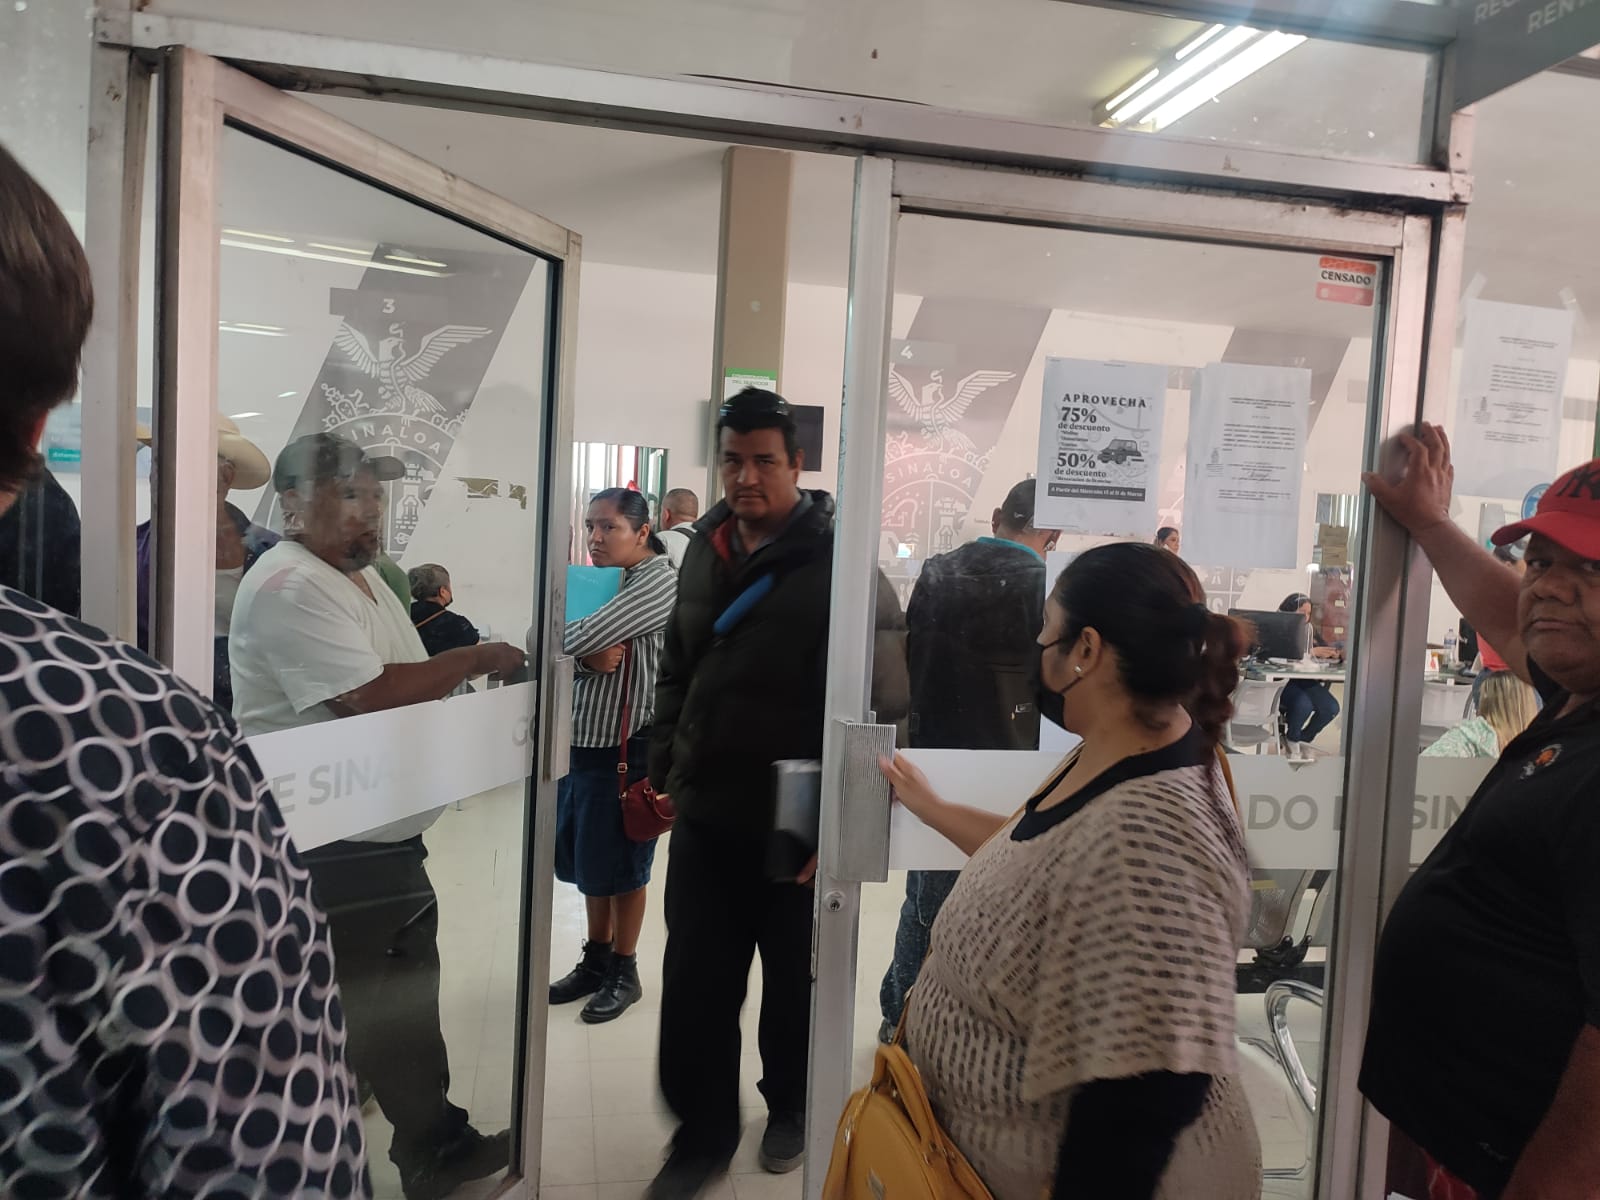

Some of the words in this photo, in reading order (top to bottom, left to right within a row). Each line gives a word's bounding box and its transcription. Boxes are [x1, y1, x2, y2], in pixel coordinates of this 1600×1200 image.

[1321, 270, 1371, 286] CENSADO
[382, 298, 396, 314] 3
[900, 345, 913, 359] 4
[1062, 393, 1147, 408] APROVECHA
[1061, 406, 1097, 423] 75%
[1069, 423, 1111, 432] descuento
[340, 424, 441, 454] INALOA
[1057, 452, 1096, 469] 50%
[885, 463, 973, 489] SINALOA
[1054, 467, 1064, 475] de
[1065, 468, 1107, 477] descuento
